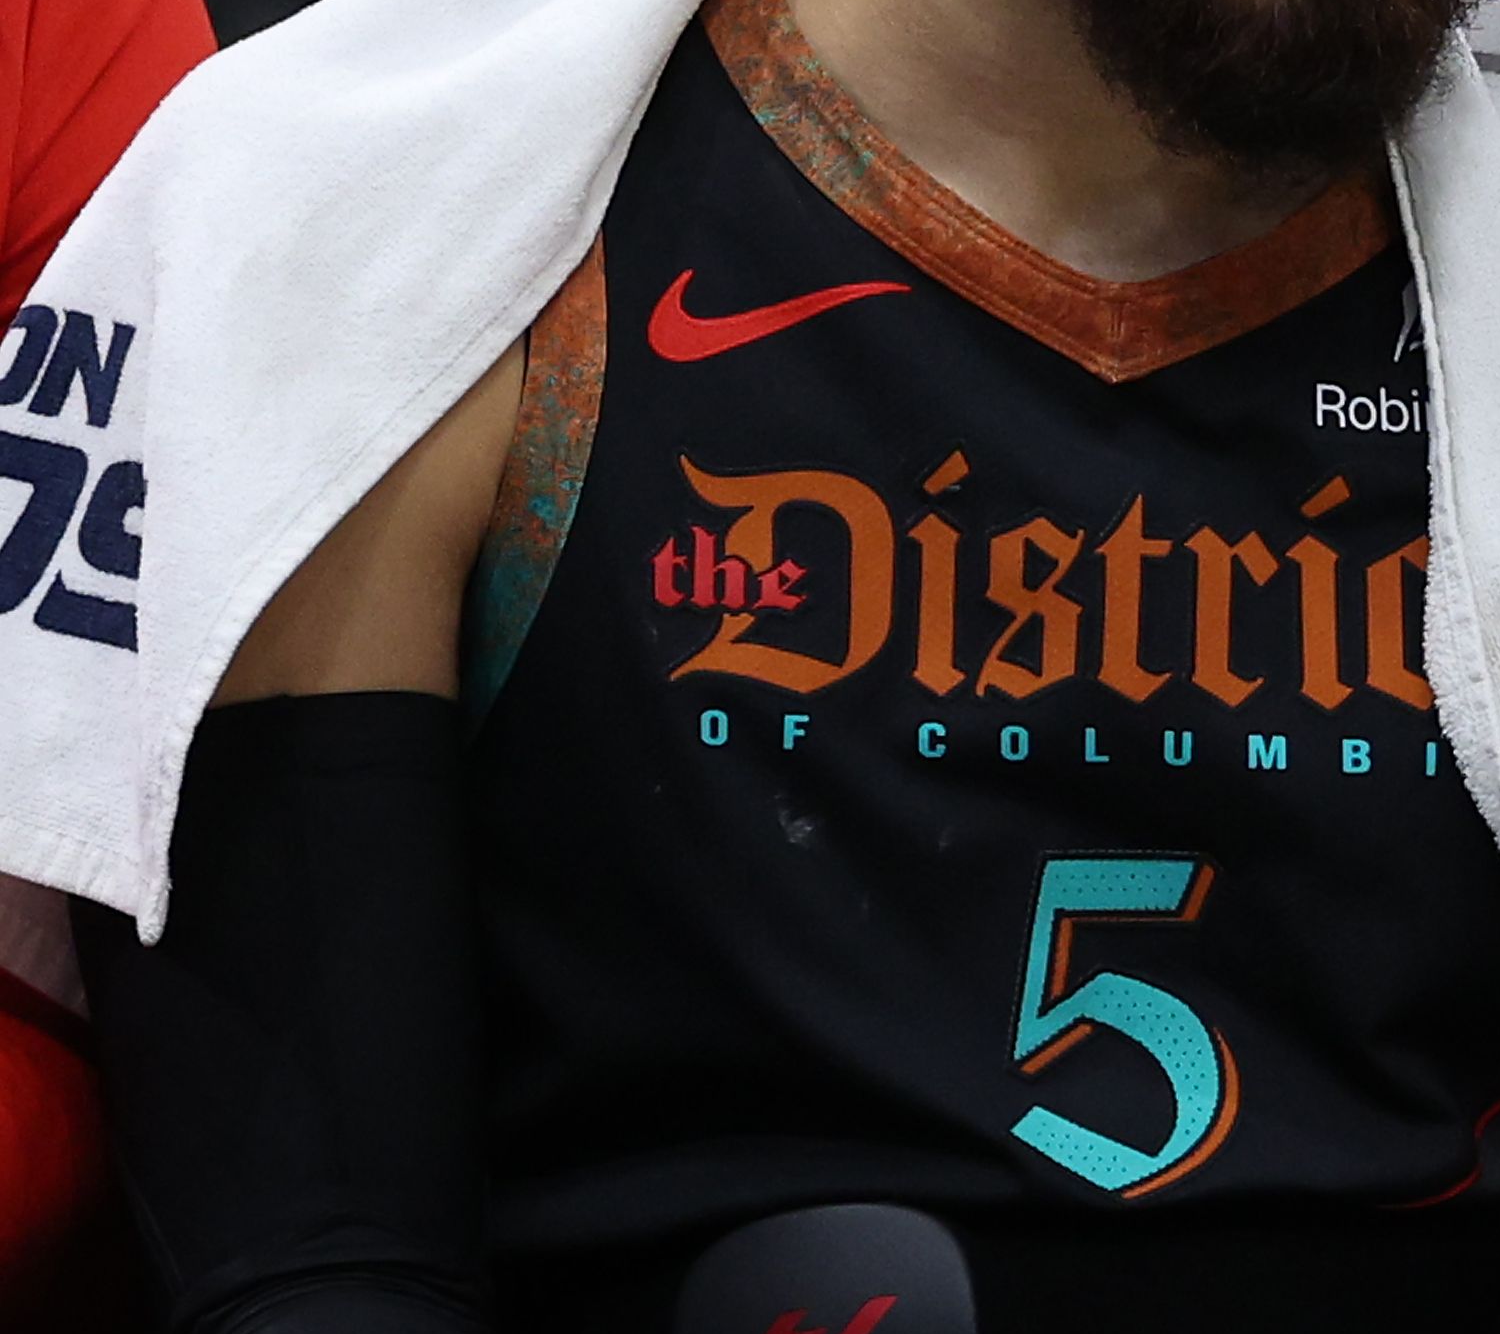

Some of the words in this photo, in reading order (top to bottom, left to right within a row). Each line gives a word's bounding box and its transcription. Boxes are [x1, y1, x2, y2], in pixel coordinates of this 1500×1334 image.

[1315, 383, 1428, 432] Robi
[651, 526, 809, 609] the
[668, 449, 1432, 711] Distric
[700, 710, 810, 749] OF
[918, 722, 1438, 777] COLUMBI
[1010, 857, 1241, 1199] 5
